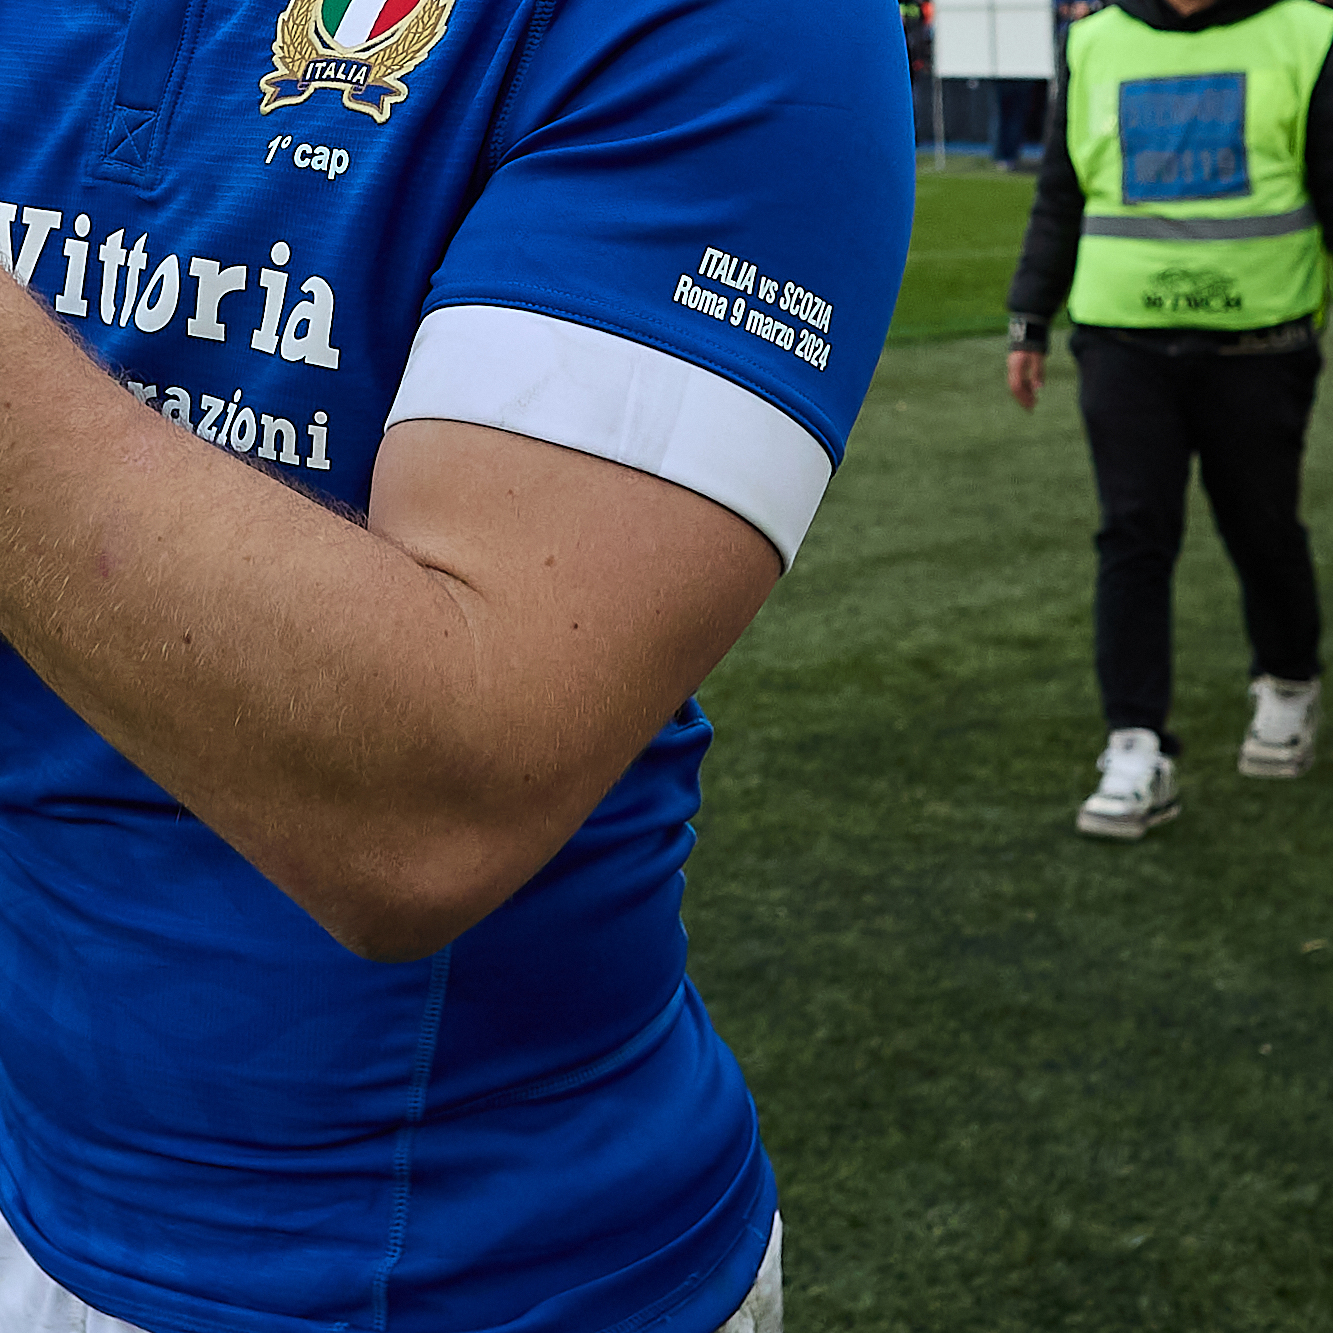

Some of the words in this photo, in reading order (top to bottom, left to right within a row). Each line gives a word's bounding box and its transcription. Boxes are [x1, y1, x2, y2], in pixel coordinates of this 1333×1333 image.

[305, 62, 368, 84] ITALIA
[293, 143, 350, 180] cap
[673, 274, 729, 321] Roma
[729, 297, 746, 326] 9
[745, 309, 795, 351] marzo
[794, 328, 832, 372] 2024
[698, 246, 757, 295] ITALIA
[757, 276, 779, 304] vs
[779, 281, 833, 334] SCOZIA
[126, 380, 331, 471] razioni
